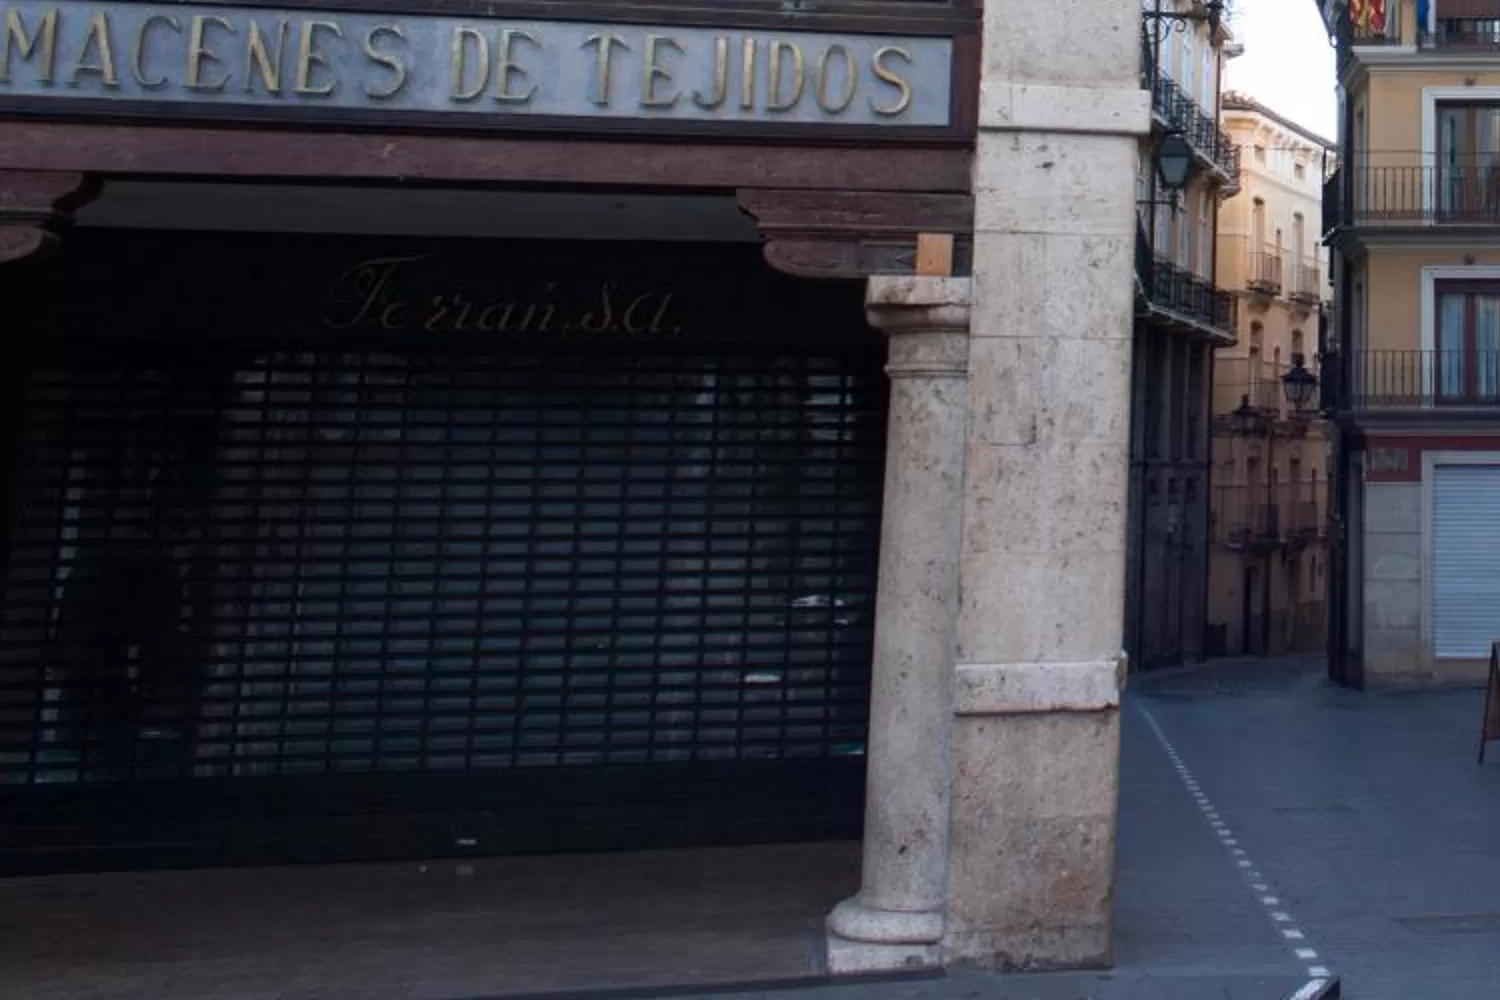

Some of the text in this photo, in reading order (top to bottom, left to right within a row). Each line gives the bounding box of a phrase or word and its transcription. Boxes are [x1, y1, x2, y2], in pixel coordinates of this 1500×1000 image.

[0, 5, 914, 117] MACENES DE TEJIDOS
